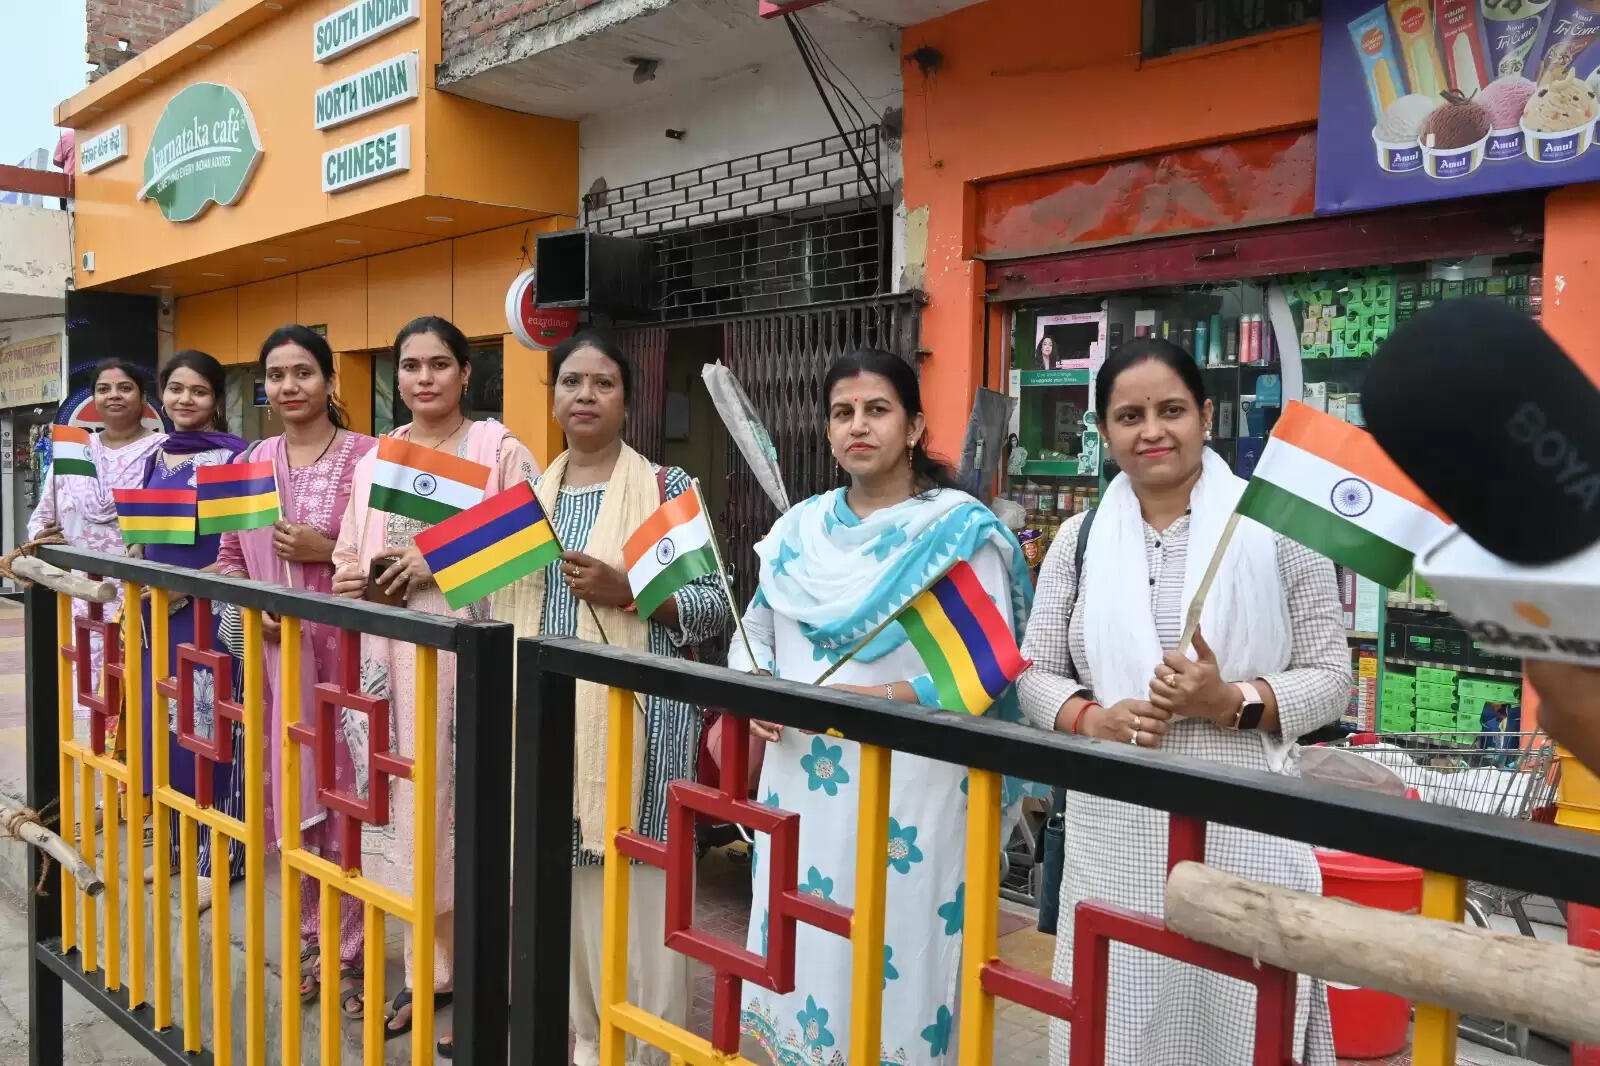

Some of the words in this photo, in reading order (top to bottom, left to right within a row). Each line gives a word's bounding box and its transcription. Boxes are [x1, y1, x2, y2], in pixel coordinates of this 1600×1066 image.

[316, 7, 358, 55] SOUTH
[1572, 10, 1593, 23] Amul
[316, 80, 358, 124] NORTH
[361, 60, 408, 108] INDIAN
[152, 115, 209, 178] karnataka
[213, 107, 240, 144] café
[1394, 151, 1419, 163] Amul
[1491, 138, 1519, 150] Amul
[1544, 140, 1573, 153] Amul
[326, 132, 397, 186] CHINESE
[1440, 157, 1466, 169] Amul
[1504, 401, 1600, 511] BOYA
